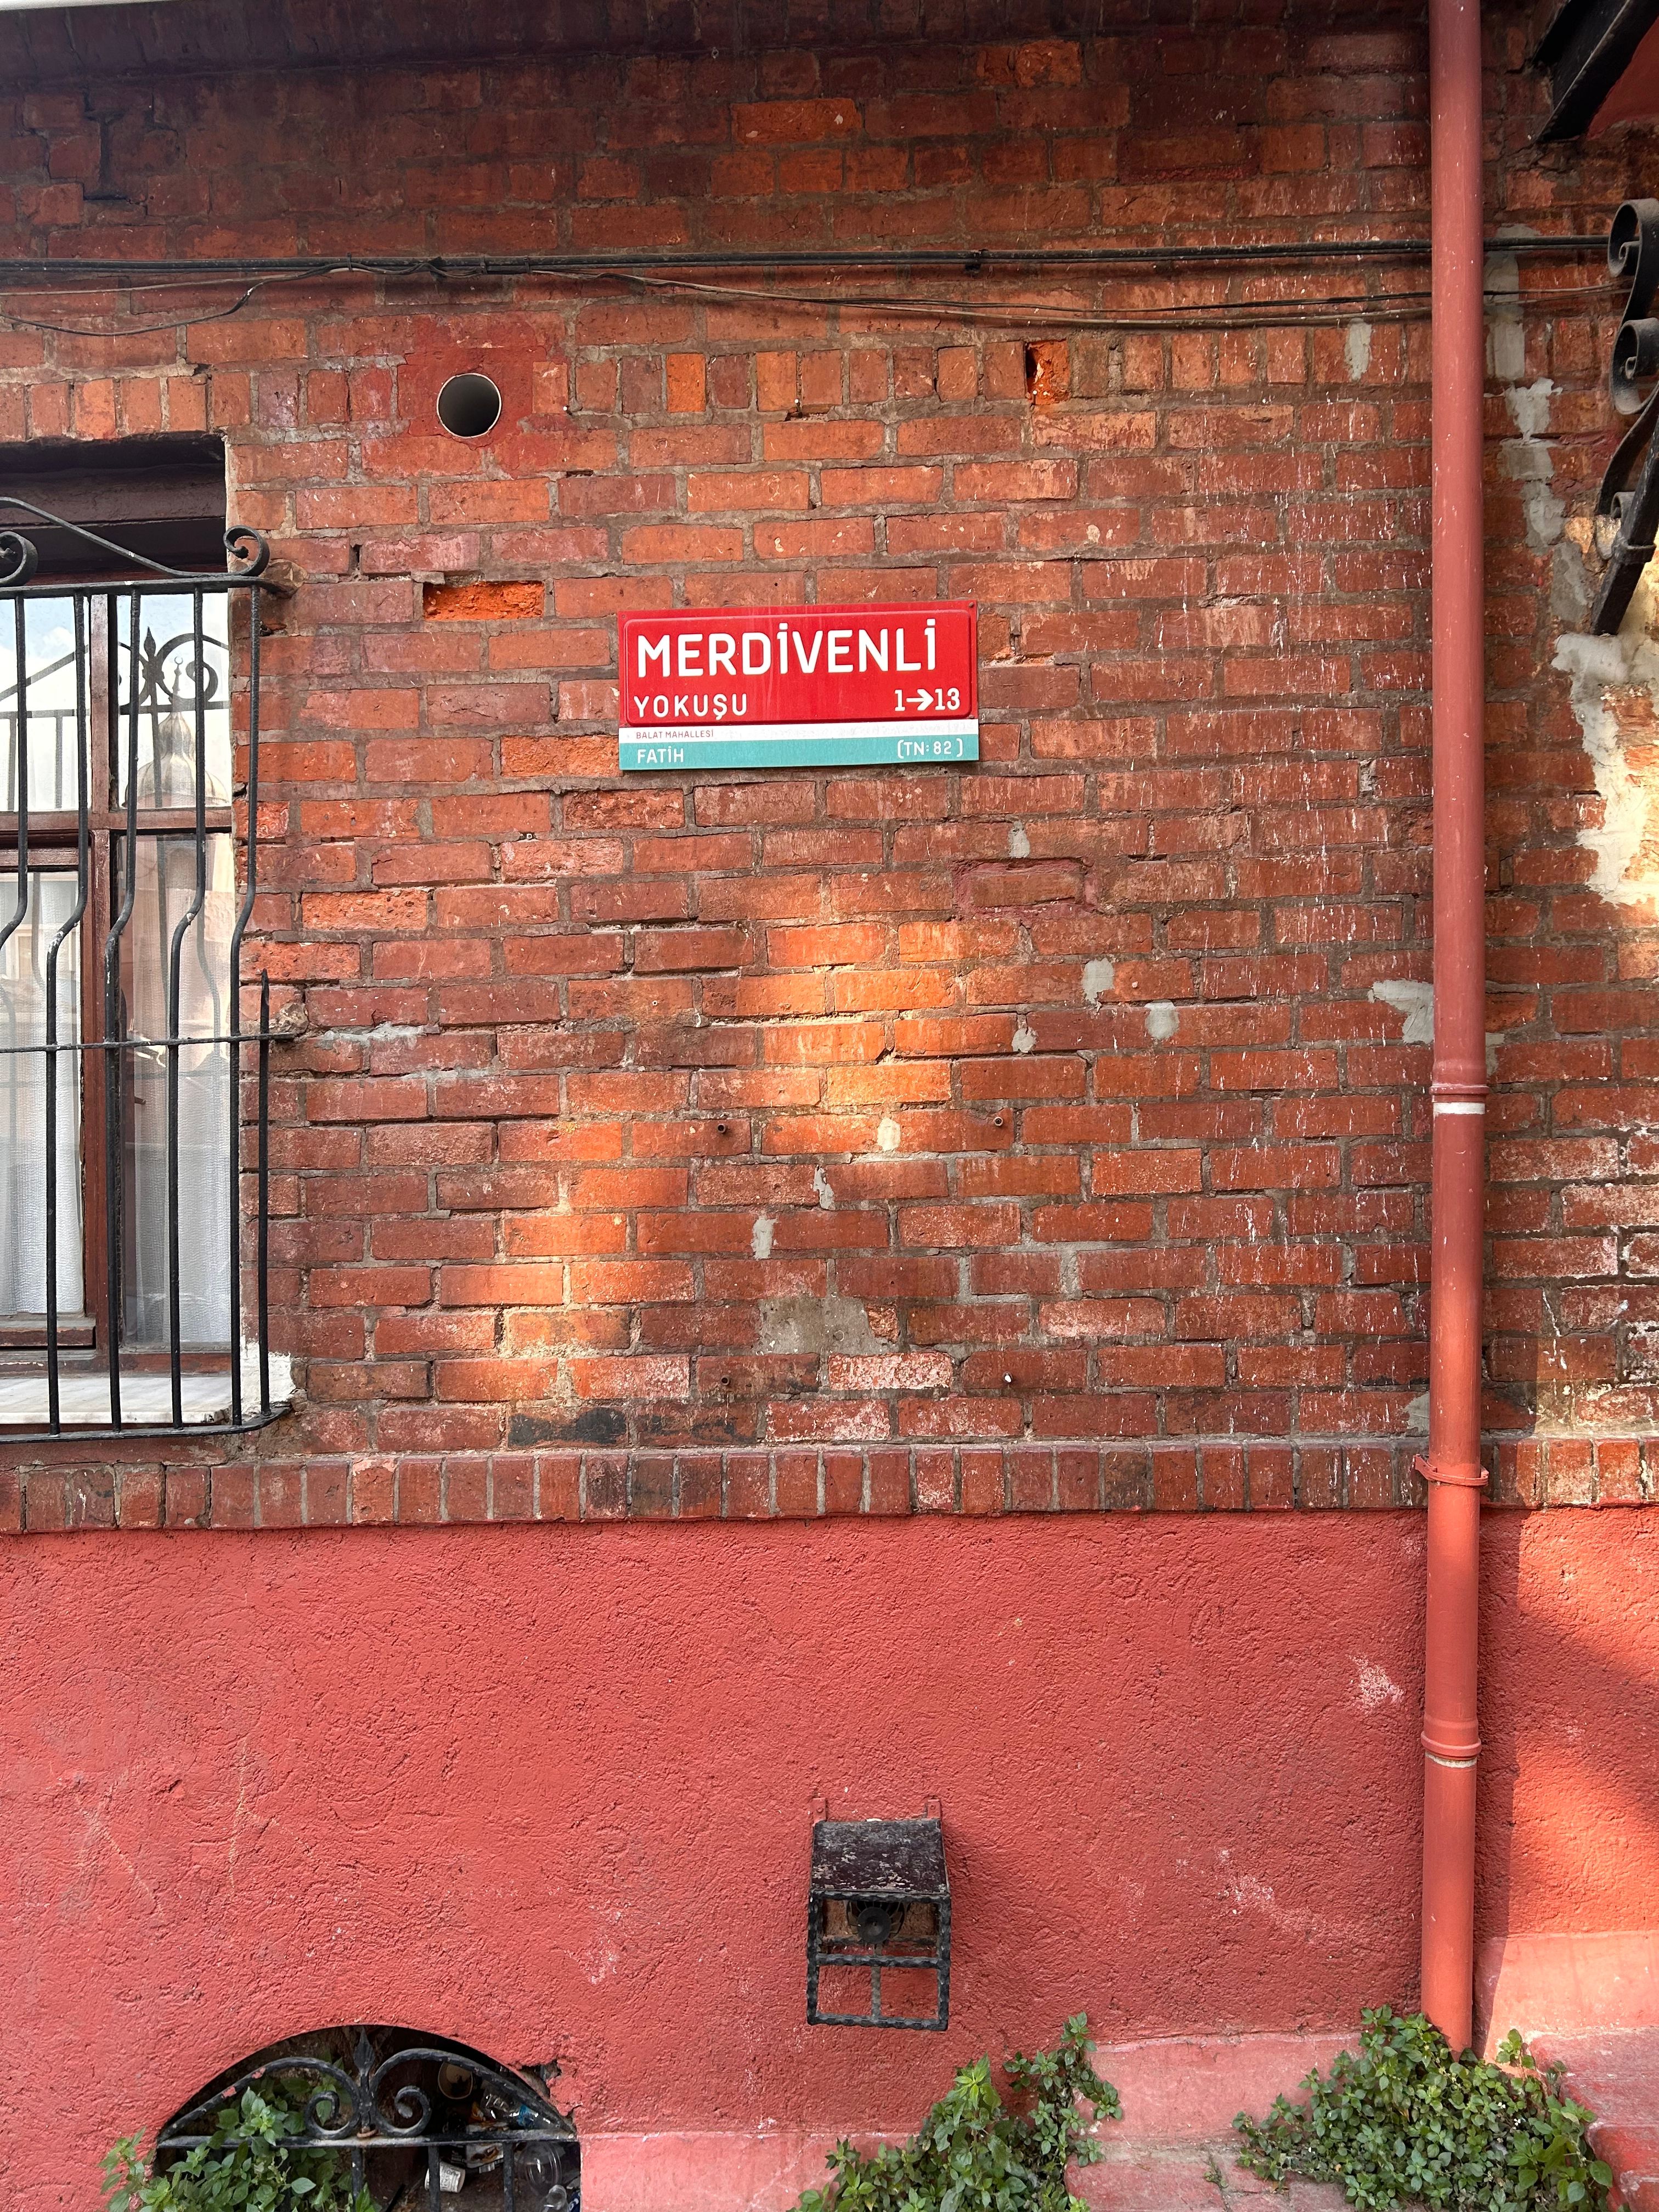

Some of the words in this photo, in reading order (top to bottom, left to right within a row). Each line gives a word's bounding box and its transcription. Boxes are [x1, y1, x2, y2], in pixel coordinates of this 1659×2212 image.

[637, 618, 936, 678] MERDİVENLİ
[634, 693, 747, 720] YOKUŞU
[636, 731, 663, 739] BALAT
[665, 729, 714, 738] MAHALLESİ
[637, 746, 684, 764] FATİH
